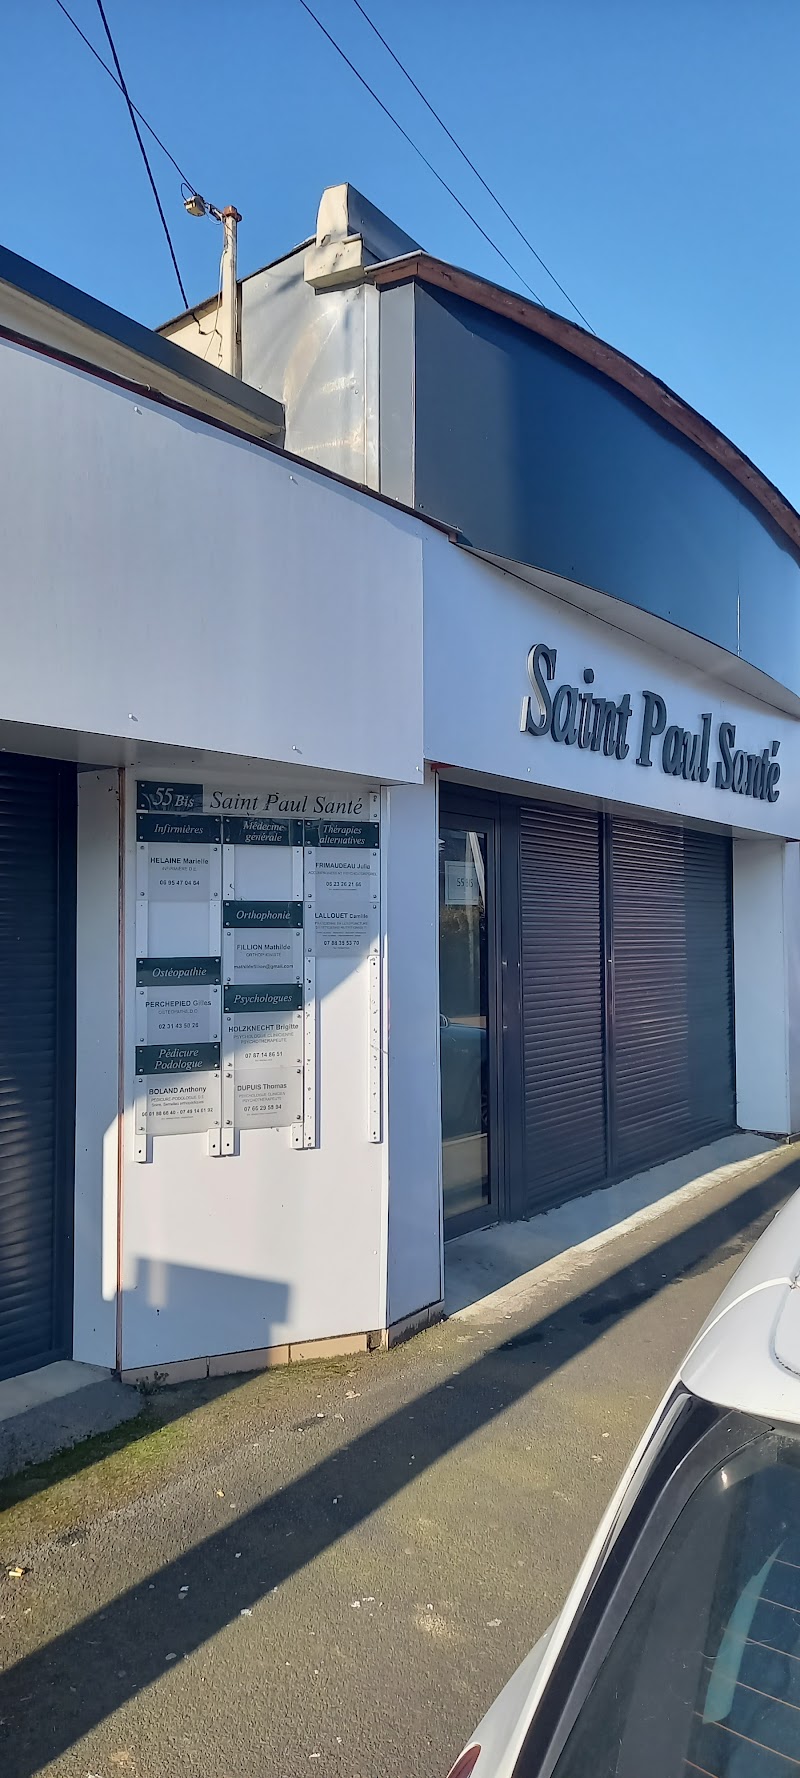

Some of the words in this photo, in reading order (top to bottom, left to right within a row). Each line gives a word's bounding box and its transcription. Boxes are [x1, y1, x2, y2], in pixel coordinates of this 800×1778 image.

[520, 643, 632, 760] Saint
[636, 690, 712, 782] Paul
[715, 722, 780, 802] Santé
[153, 787, 173, 806] 55
[174, 794, 195, 807] Bis
[210, 791, 258, 810] Saint
[263, 793, 308, 812] Paul
[313, 796, 363, 815] Santé
[154, 823, 203, 834] Infirmières
[243, 820, 284, 832] Médecine
[323, 825, 362, 836] Thérapies
[245, 832, 282, 843] générale
[319, 835, 365, 845] alternatives
[236, 909, 291, 922] Orthophonie
[152, 966, 207, 978] Ostéopathie
[145, 1000, 191, 1008] PERCHEPIED
[233, 993, 293, 1005] Psychologues
[228, 1024, 274, 1033] HOLZKNECHT
[275, 1023, 299, 1031] Brigitte
[158, 1048, 199, 1058] Pédicure
[154, 1059, 203, 1070] Podologue
[148, 1087, 178, 1095] BOLAND
[237, 1084, 262, 1092] DUPUIS
